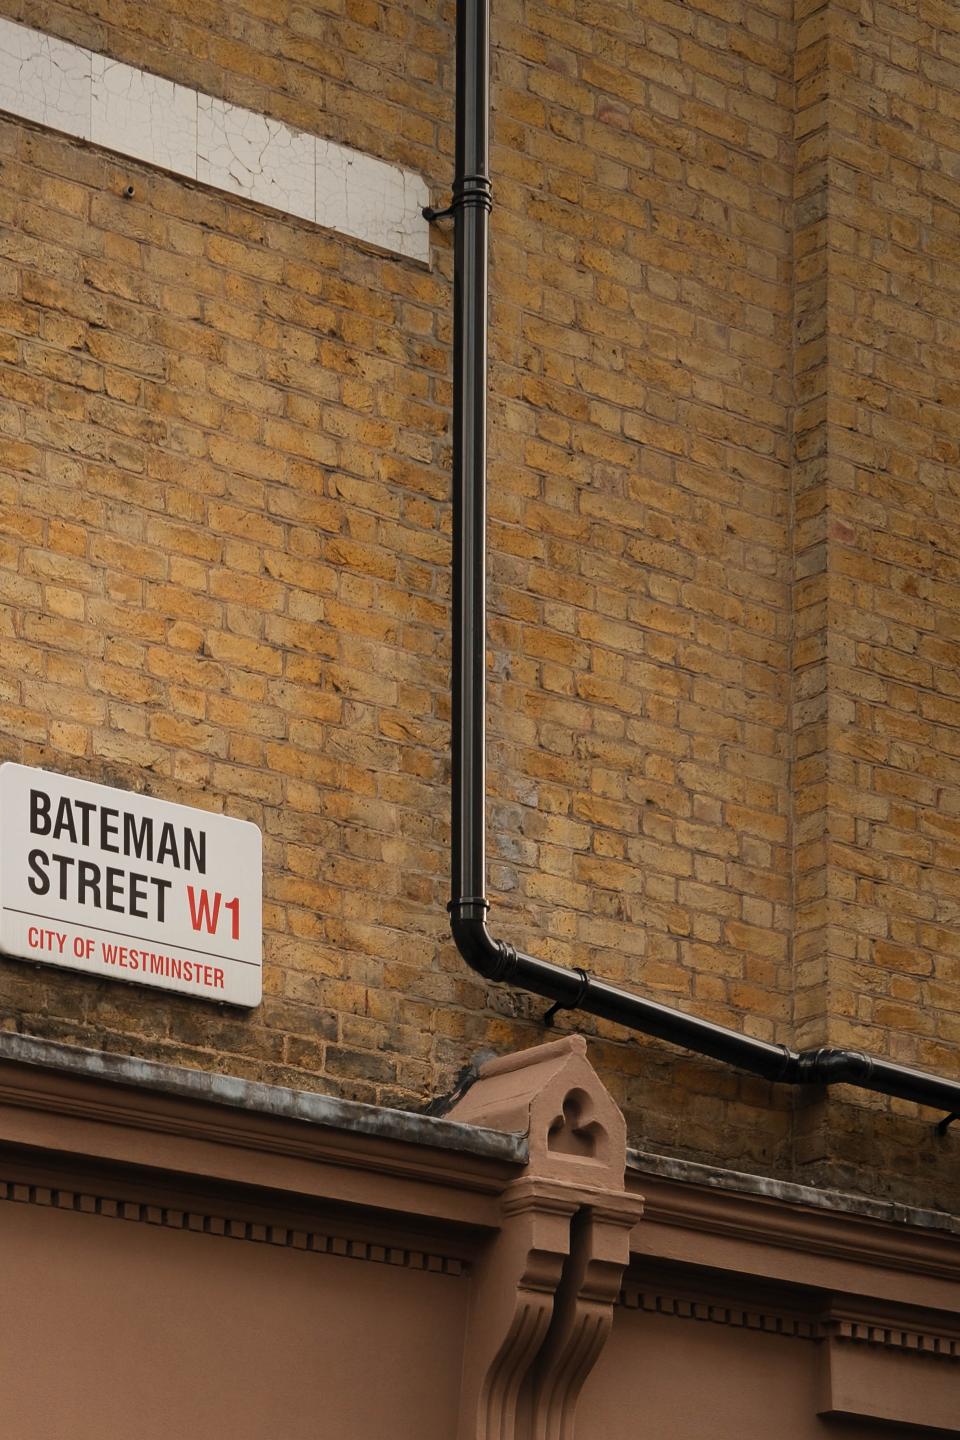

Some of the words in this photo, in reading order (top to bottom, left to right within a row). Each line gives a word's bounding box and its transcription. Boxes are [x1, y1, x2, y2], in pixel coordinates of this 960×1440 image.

[29, 788, 206, 875] BATEMAN
[27, 848, 172, 923] STREET
[186, 885, 240, 941] W1
[28, 926, 67, 953] CITY
[73, 936, 95, 960] OF
[101, 942, 225, 989] WESTMINSTER
